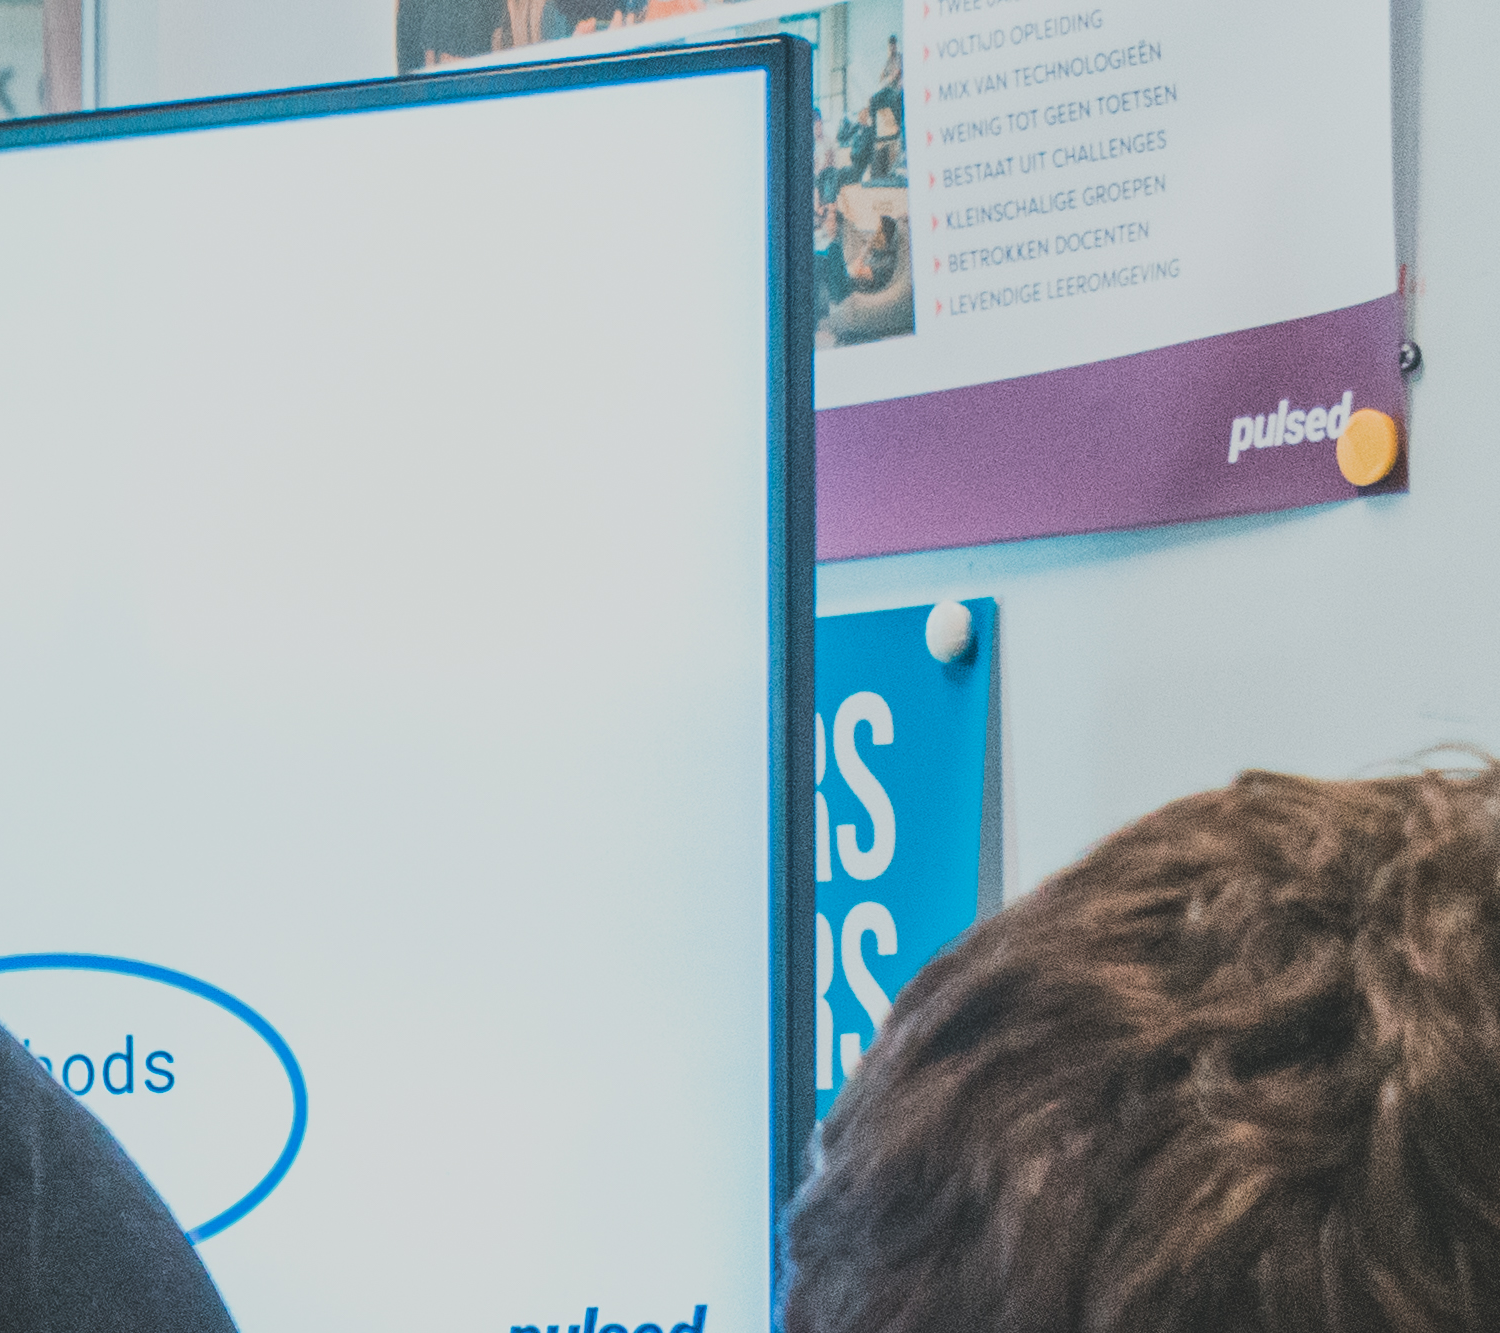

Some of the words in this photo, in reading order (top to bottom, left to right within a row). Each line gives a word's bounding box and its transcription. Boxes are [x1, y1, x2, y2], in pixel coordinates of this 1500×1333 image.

[937, 28, 1005, 59] VOLTIJD
[1010, 9, 1103, 46] OPLEIDING
[938, 82, 970, 101] MIX
[975, 71, 1008, 94] VAN
[1013, 40, 1162, 87] TECHNOLOGIEËN
[940, 116, 1002, 144] WEINIG
[1007, 109, 1038, 132] TOT
[1044, 100, 1091, 126] GEEN
[1096, 84, 1178, 115] TOETSEN
[943, 156, 1014, 188] BESTAAT
[1019, 151, 1046, 174] UIT
[1052, 129, 1167, 169] CHALLENGES
[946, 189, 1077, 230] KLEINSCHALIGE
[1082, 174, 1166, 206] GROEPEN
[948, 238, 1049, 273] BETROKKEN
[1055, 221, 1150, 255] DOCENTEN
[950, 282, 1042, 316] LEVENDIGE
[1047, 258, 1180, 299] LEEROMGEVING
[1227, 390, 1353, 464] pulsed
[23, 1033, 176, 1097] ods
